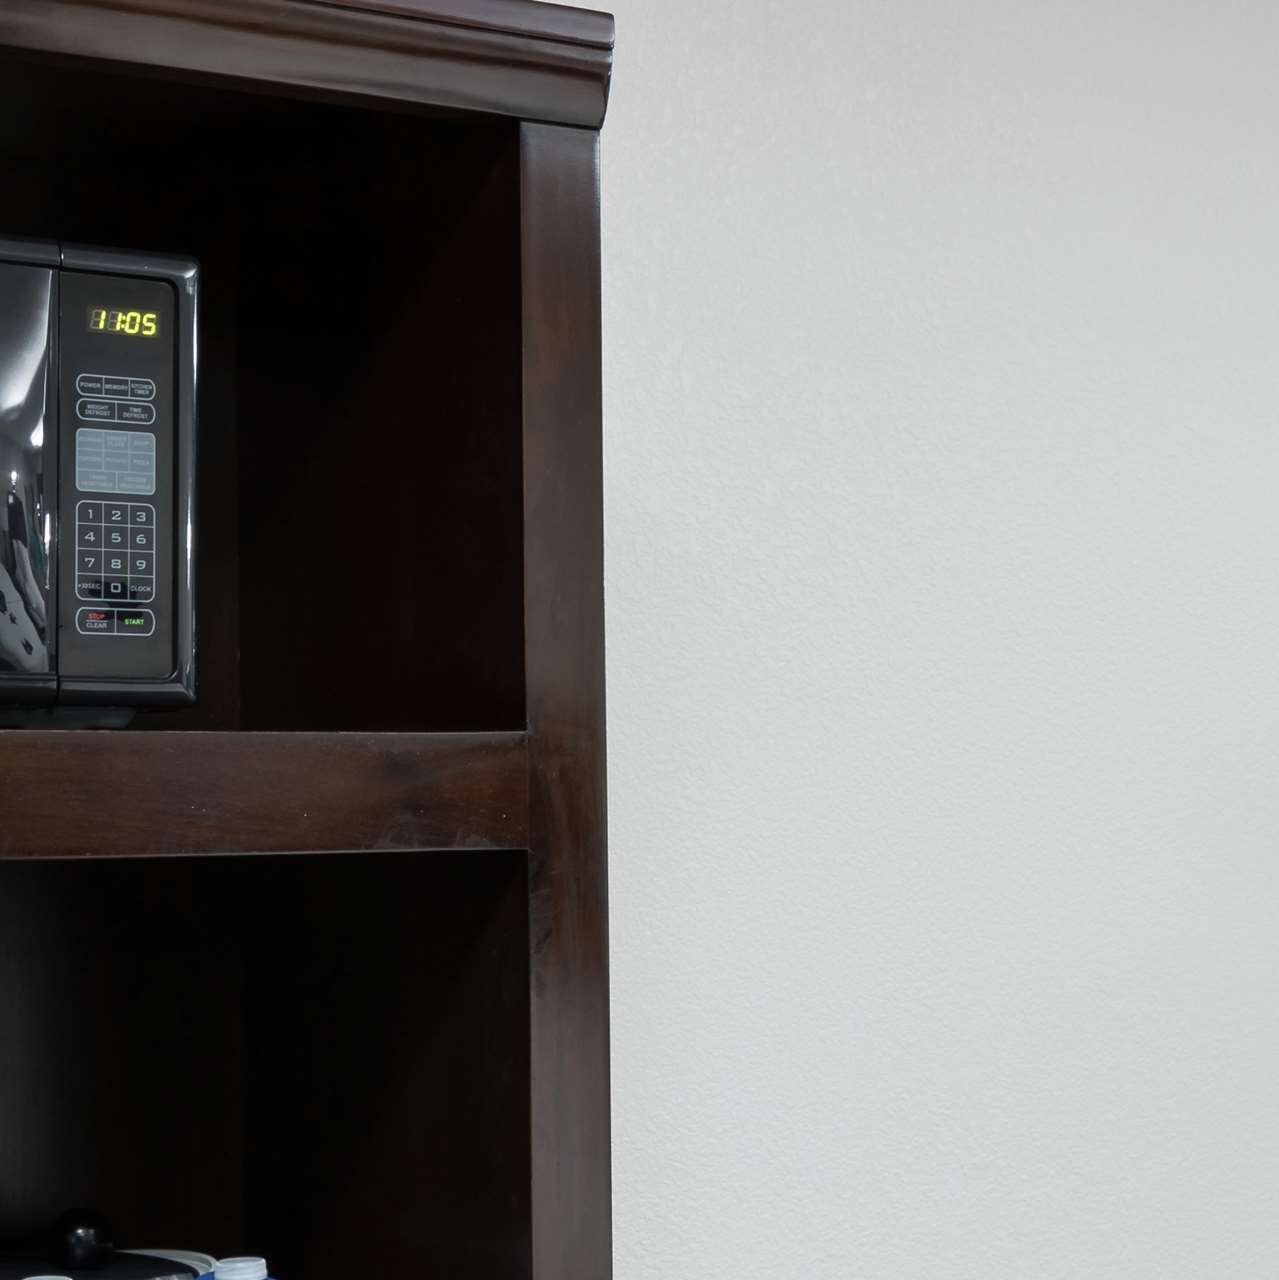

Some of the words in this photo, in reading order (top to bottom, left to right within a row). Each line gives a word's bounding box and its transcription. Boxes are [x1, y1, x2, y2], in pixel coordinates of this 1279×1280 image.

[99, 310, 156, 335] 11:05
[88, 509, 94, 519] 1
[111, 510, 121, 520] 2
[136, 511, 146, 521] 3
[84, 531, 95, 542] 4
[111, 532, 121, 543] 5
[136, 534, 146, 544] 6
[84, 557, 95, 568] 7
[111, 559, 121, 569] 8
[136, 560, 146, 570] 9
